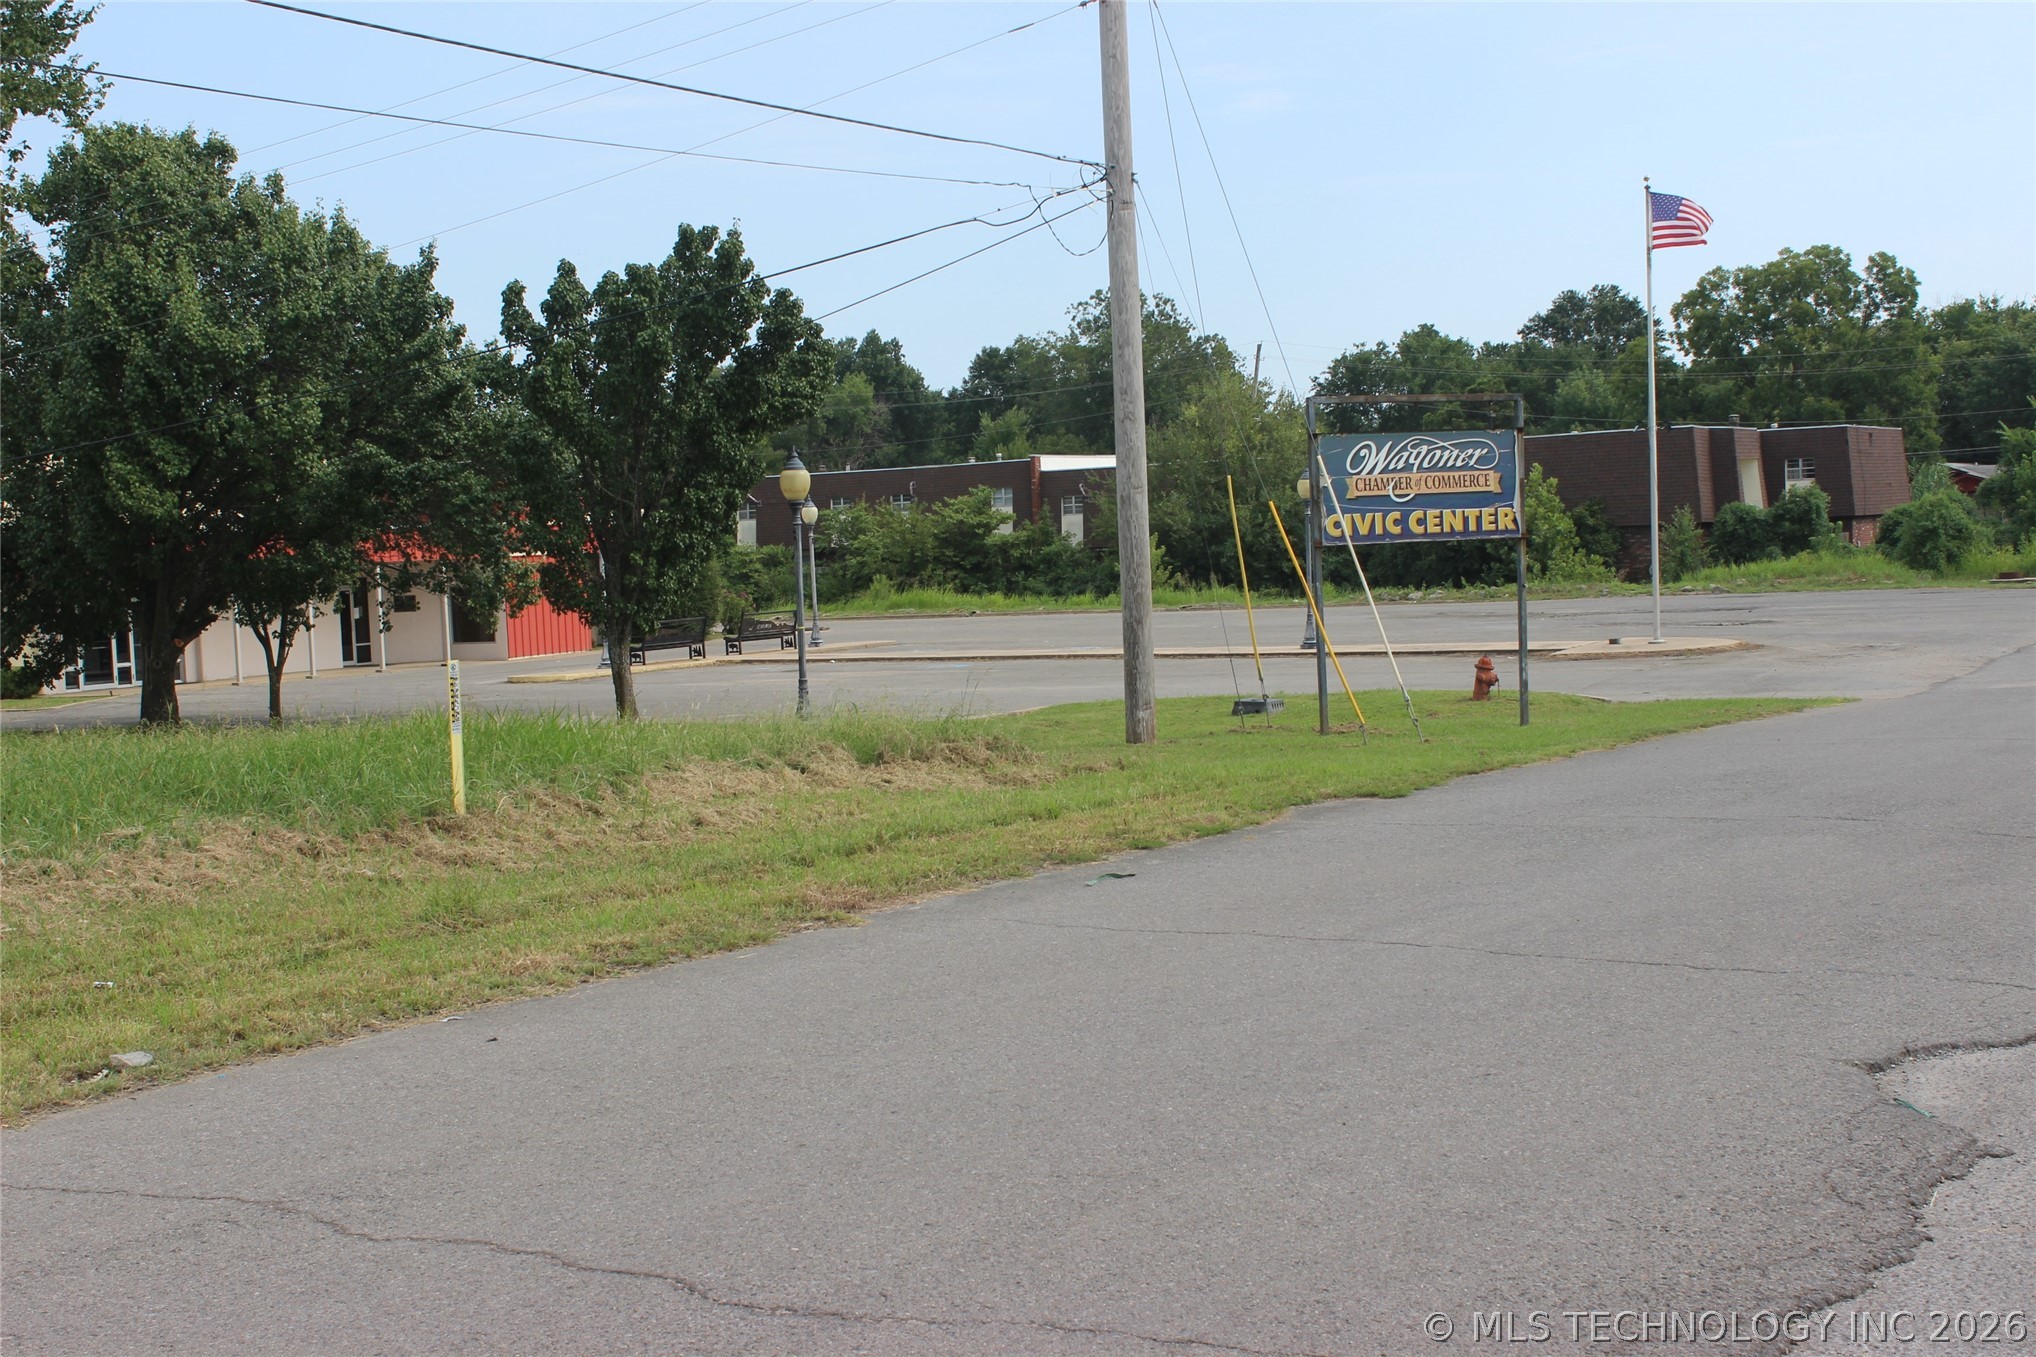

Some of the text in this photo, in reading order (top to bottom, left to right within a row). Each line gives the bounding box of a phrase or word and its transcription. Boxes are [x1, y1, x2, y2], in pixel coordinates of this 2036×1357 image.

[1346, 435, 1499, 502] Wagoner
[1355, 473, 1491, 492] CHAMBER of COMMERCE
[1325, 507, 1518, 538] CIVIC CENTER
